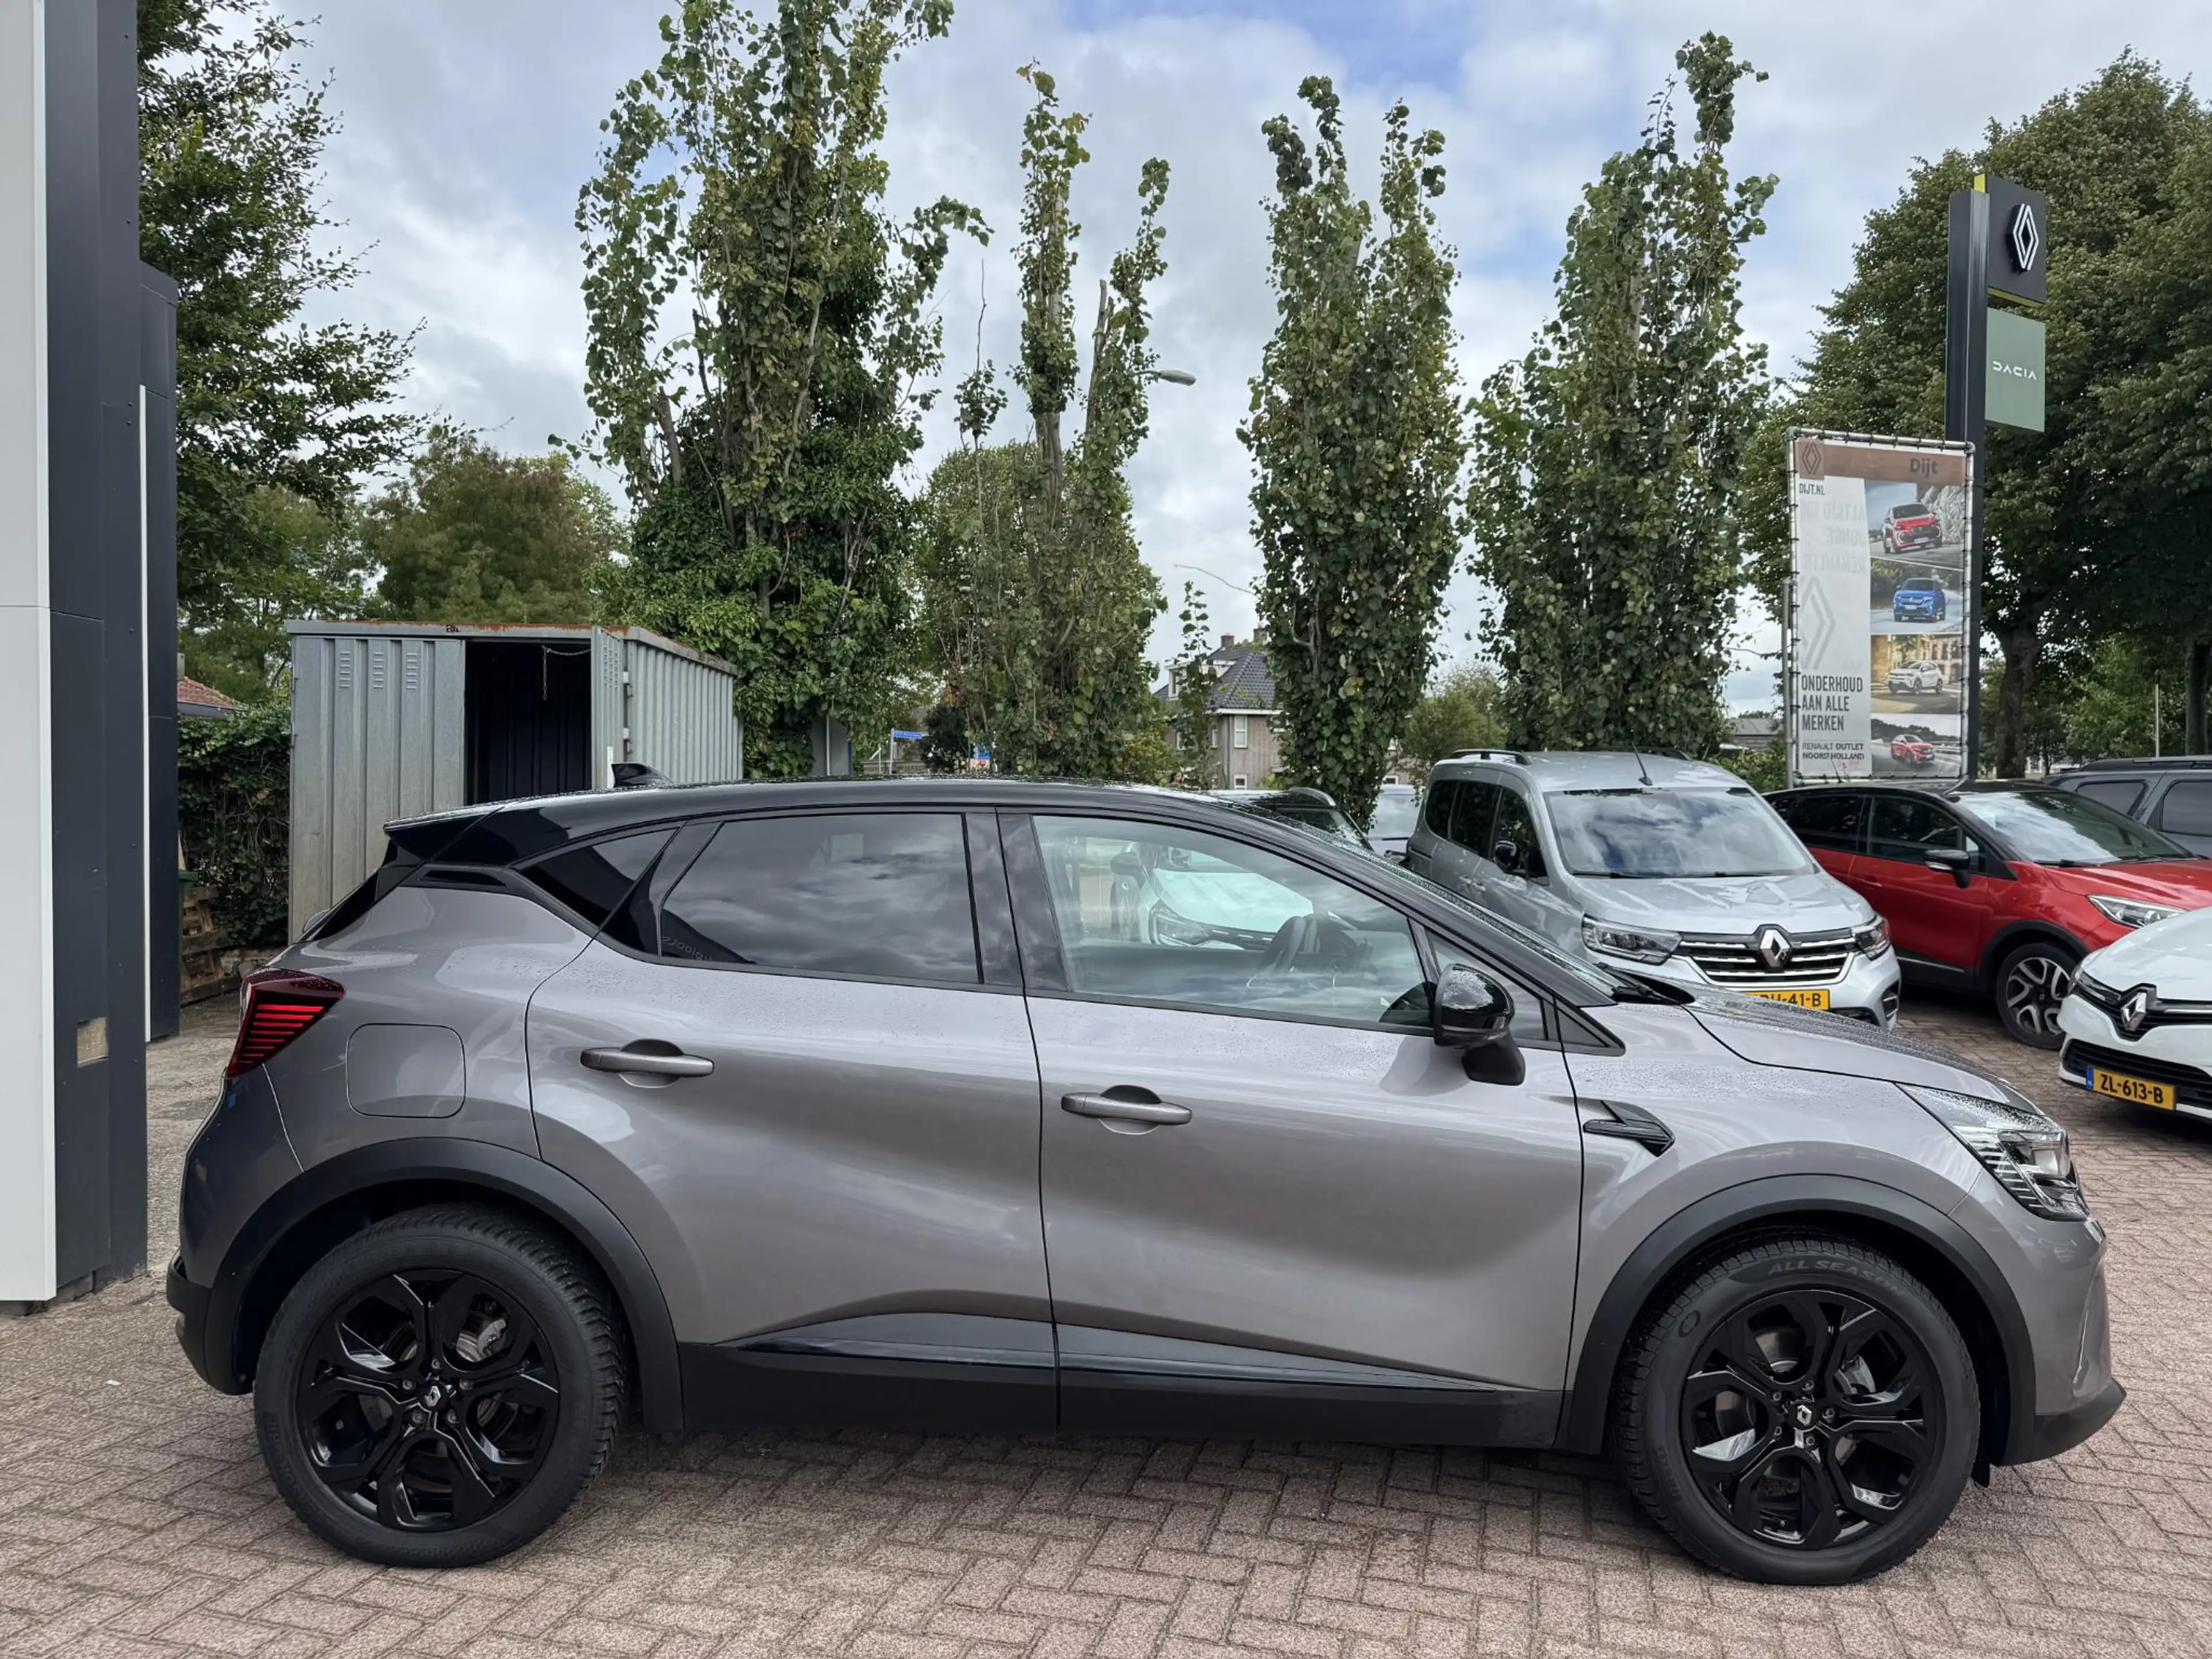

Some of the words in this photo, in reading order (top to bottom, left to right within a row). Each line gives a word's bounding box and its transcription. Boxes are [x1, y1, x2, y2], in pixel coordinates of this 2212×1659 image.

[1993, 360, 2037, 381] DACIA
[1910, 458, 1938, 477] Dijt
[1799, 483, 1825, 495] DIJT.NL
[1801, 675, 1863, 692] ONDERHOUD
[1802, 694, 1822, 711] AAN
[1825, 695, 1850, 711] ALLE
[1802, 714, 1844, 732] MERKEN
[1802, 742, 1834, 750] RENAULT
[1835, 743, 1864, 751] OUTLET
[2100, 1073, 2164, 1104] ZL-613-B
[1768, 1260, 1810, 1275] ALL
